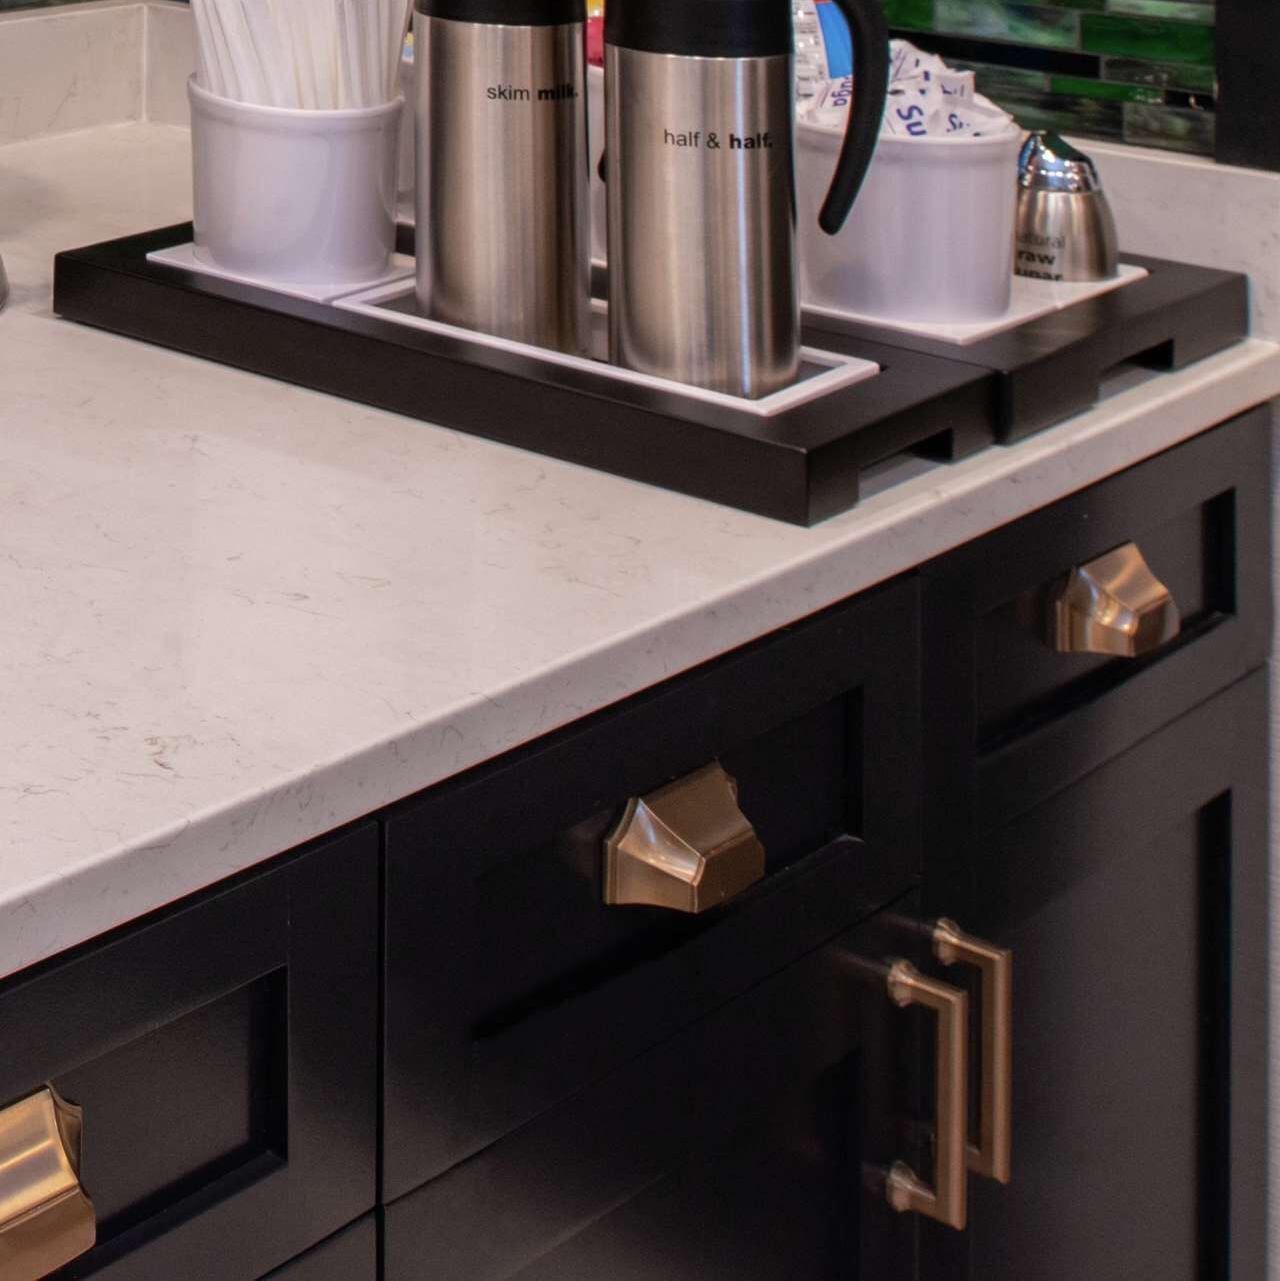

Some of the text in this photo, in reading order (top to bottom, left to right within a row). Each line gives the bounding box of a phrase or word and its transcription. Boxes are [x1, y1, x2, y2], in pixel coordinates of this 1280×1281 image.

[487, 85, 530, 101] skim
[664, 128, 773, 149] half & half.
[1017, 250, 1056, 265] raw
